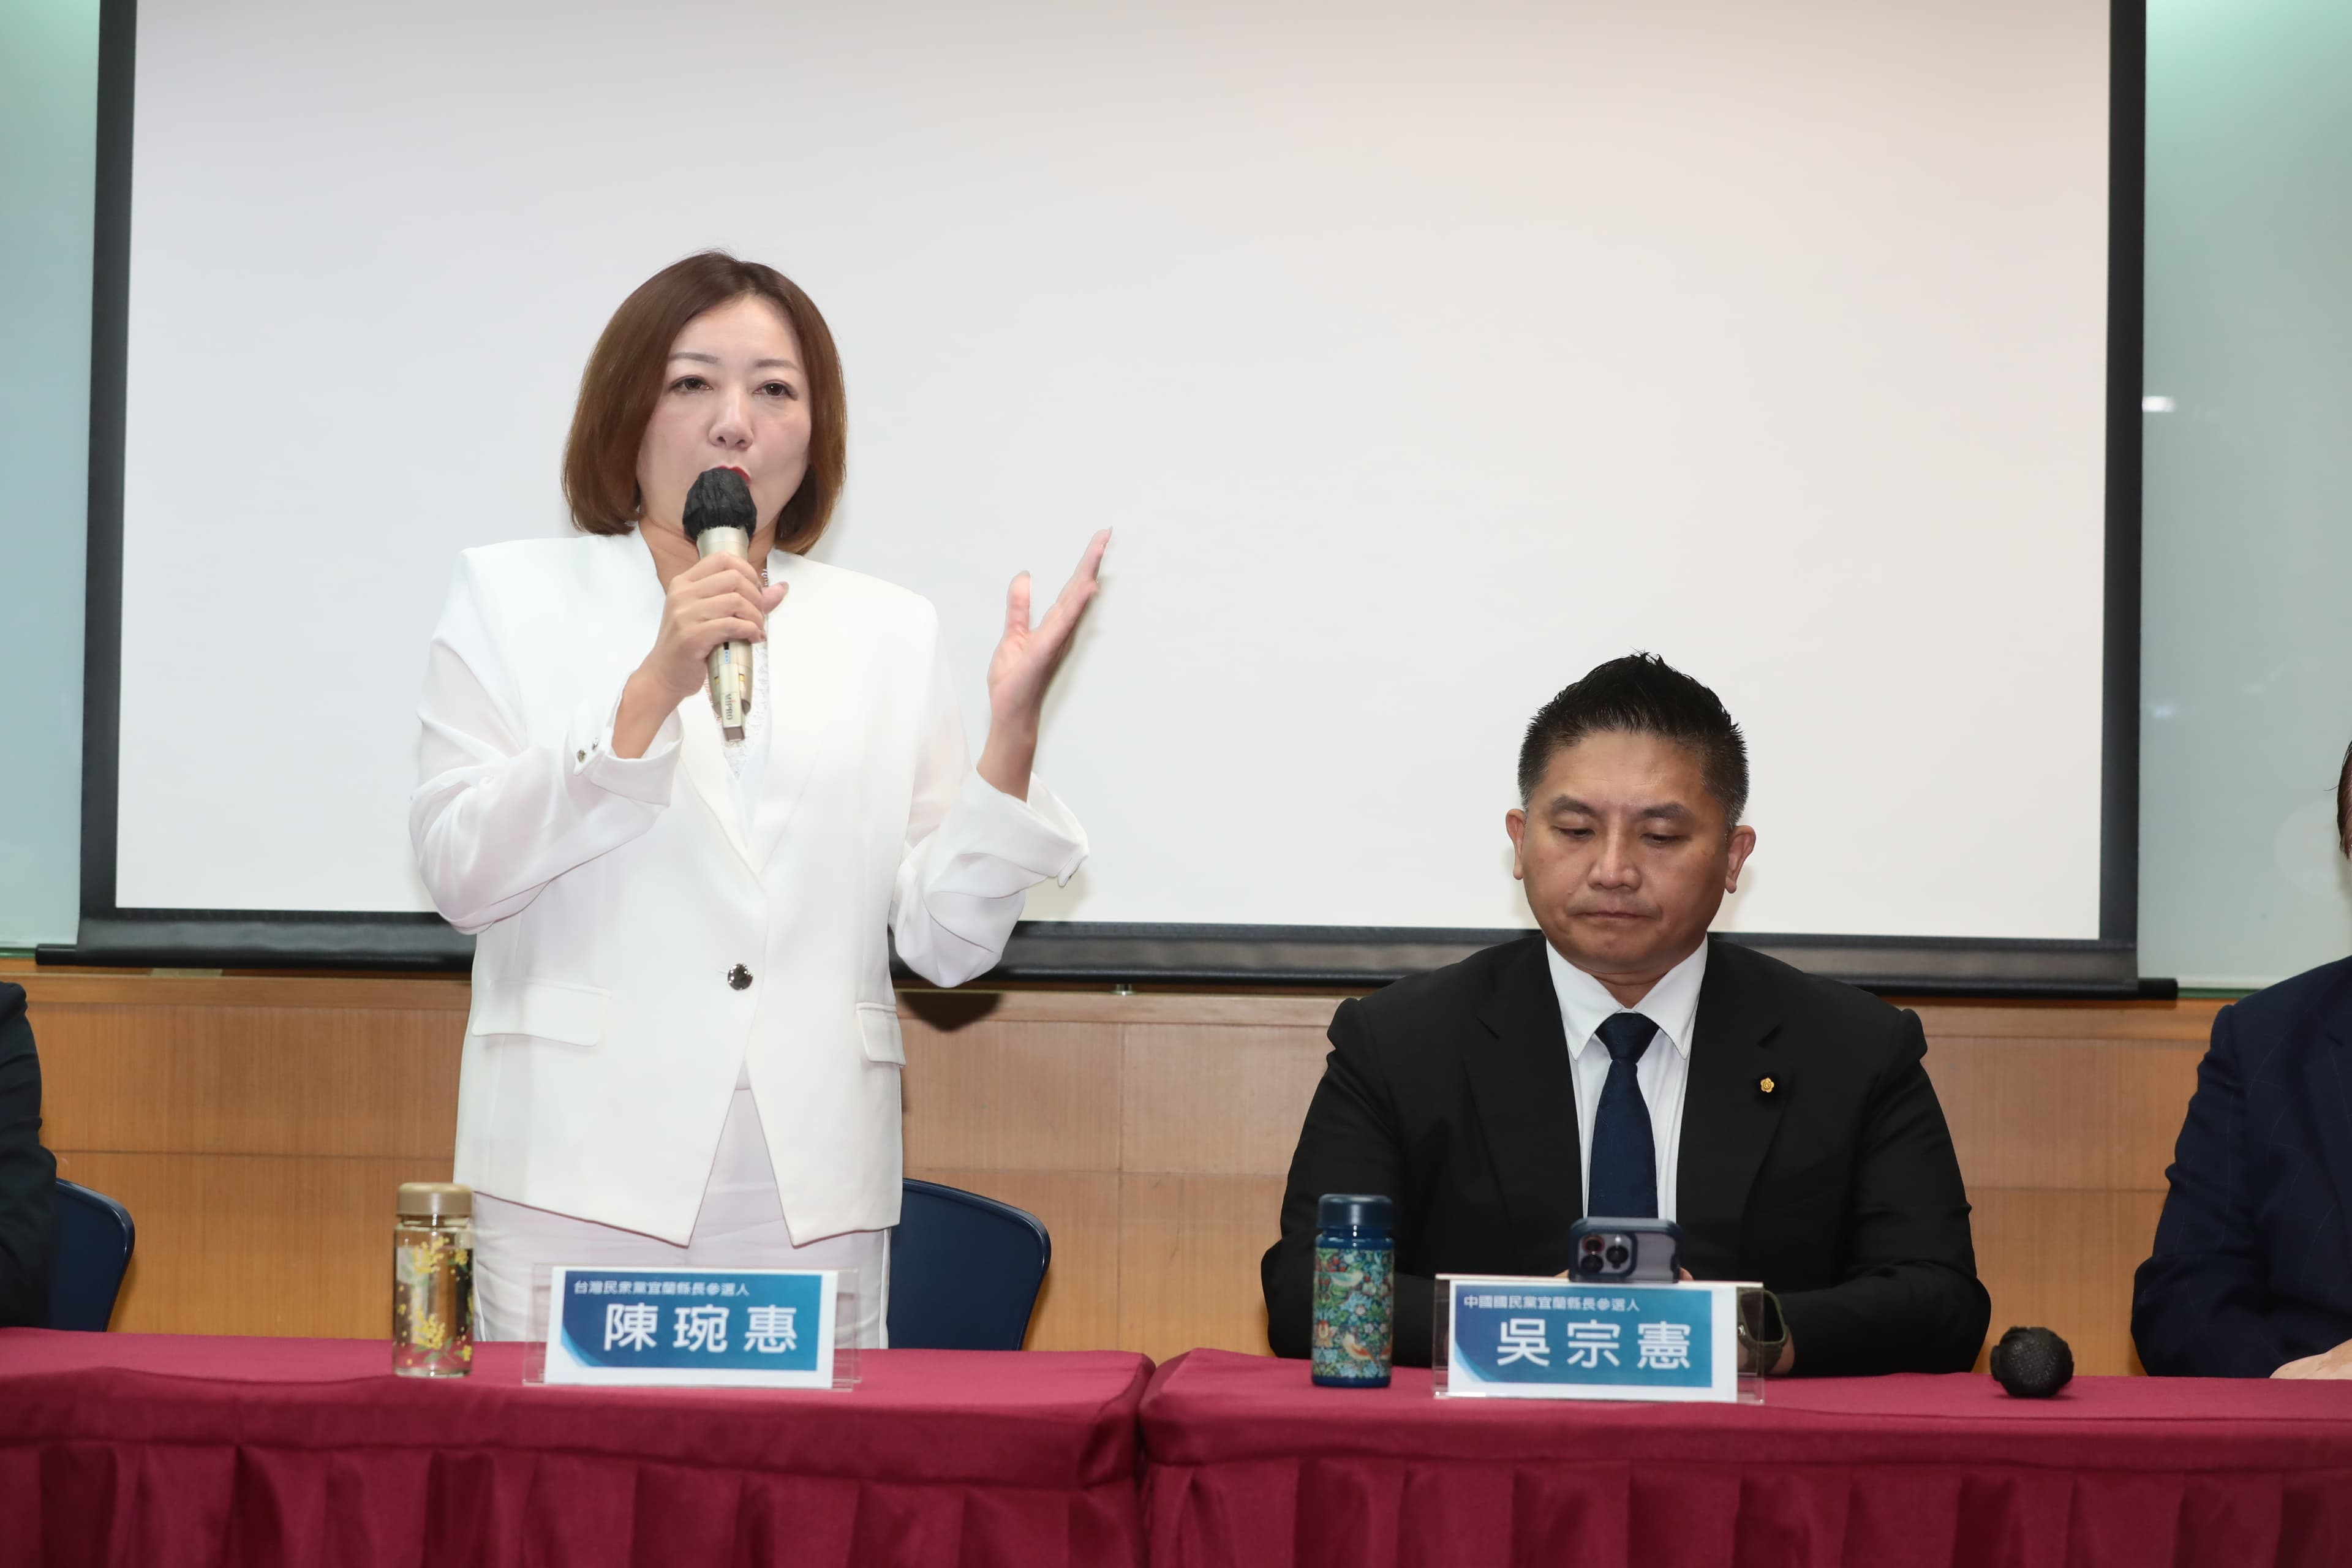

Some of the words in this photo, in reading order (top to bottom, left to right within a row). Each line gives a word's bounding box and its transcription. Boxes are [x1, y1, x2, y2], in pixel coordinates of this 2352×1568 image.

[604, 1302, 797, 1353] 陳琬惠
[1497, 1318, 1691, 1370] 吳宗憲
